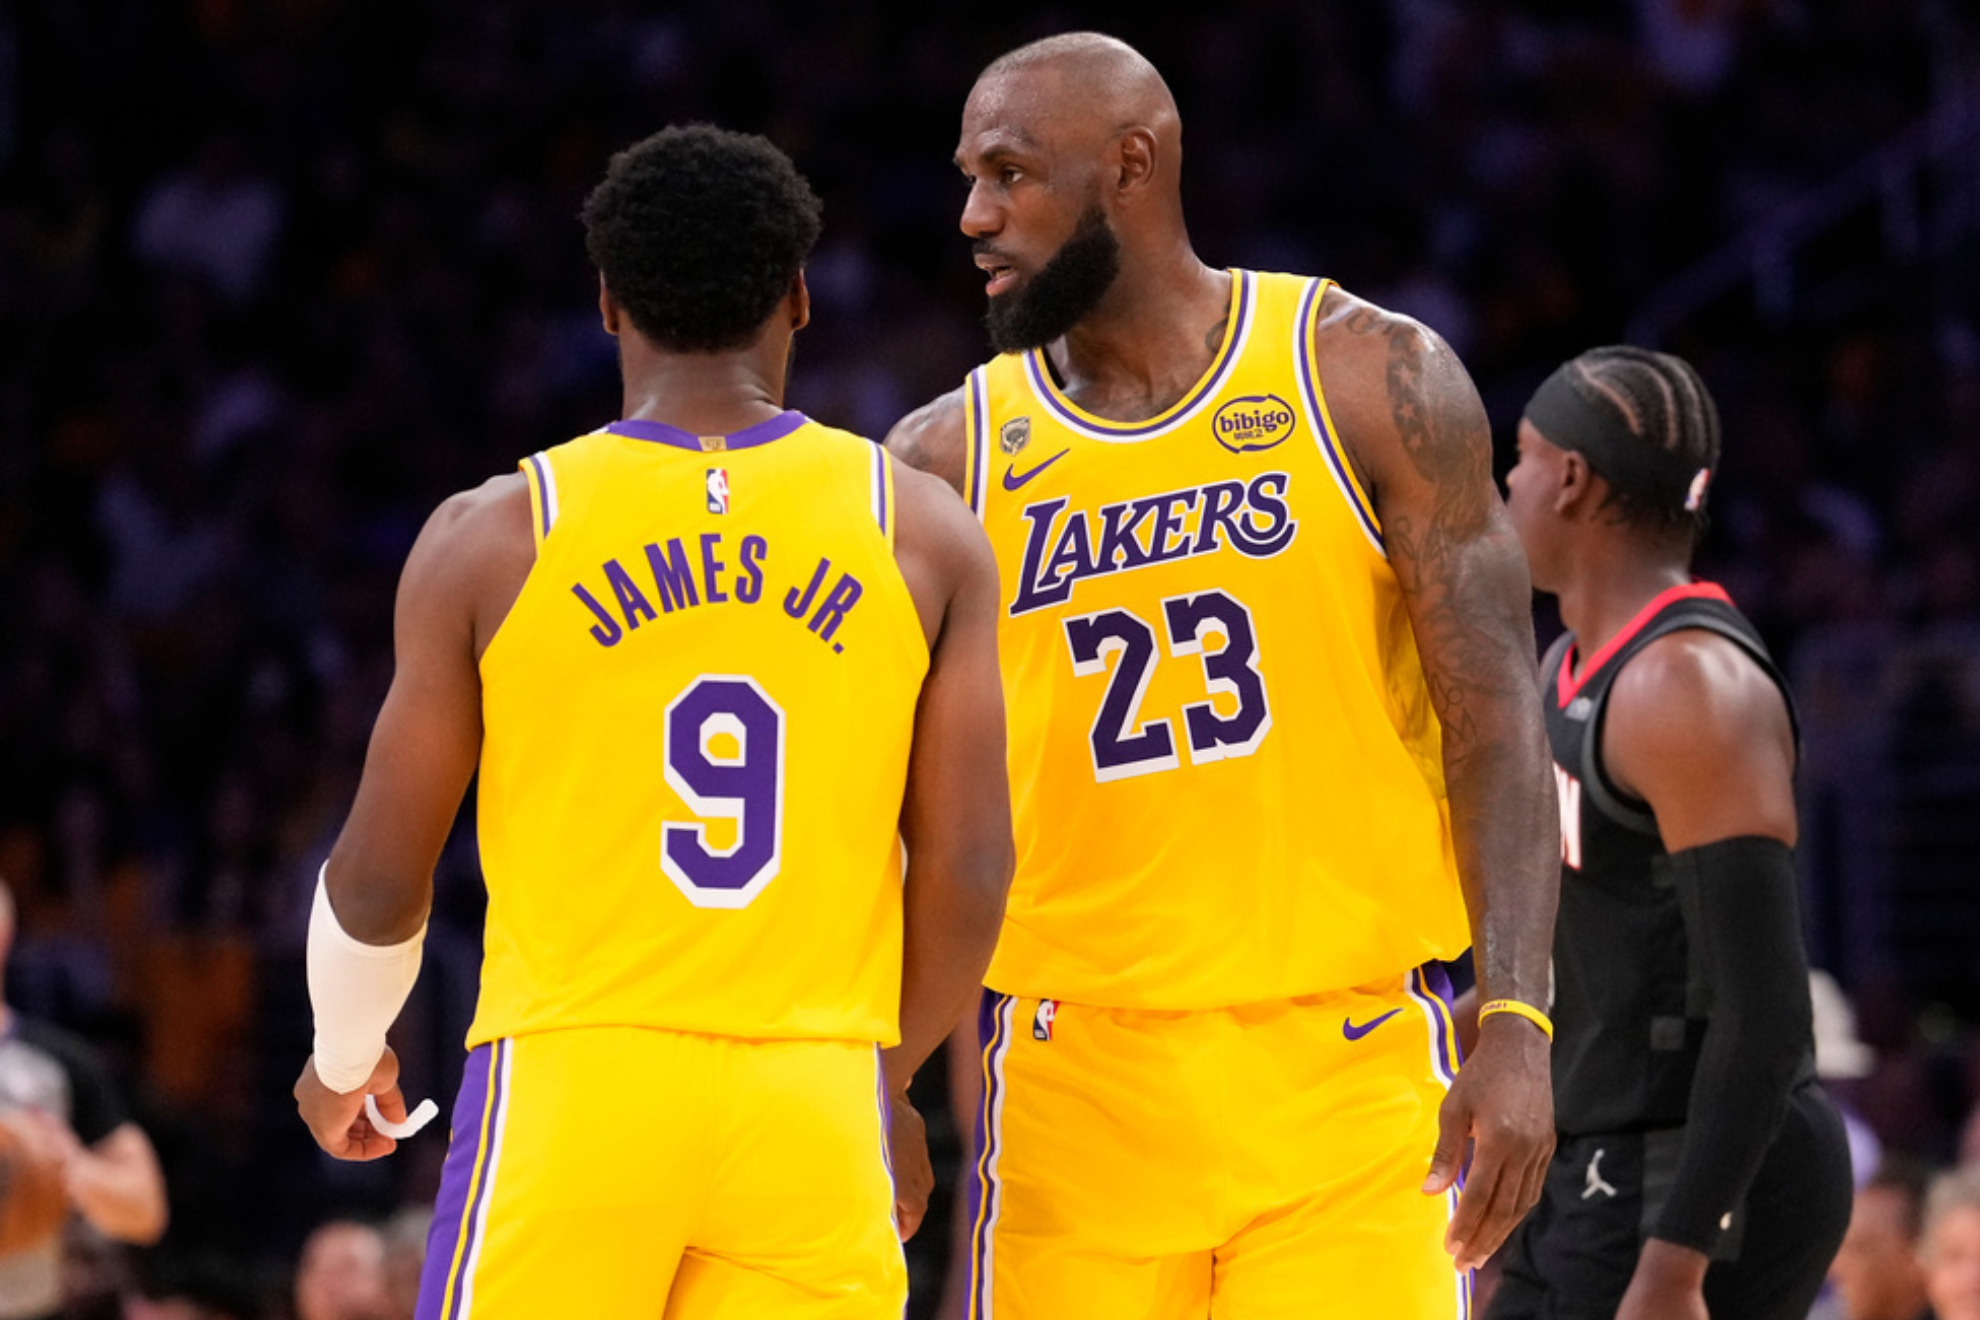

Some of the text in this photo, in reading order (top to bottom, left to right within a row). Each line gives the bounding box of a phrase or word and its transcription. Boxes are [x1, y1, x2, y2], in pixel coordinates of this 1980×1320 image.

[1220, 410, 1289, 433] bibigo
[571, 533, 863, 655] JAMES JR.
[1010, 471, 1298, 617] LAKERS
[1061, 587, 1273, 783] 23
[660, 673, 786, 909] 9
